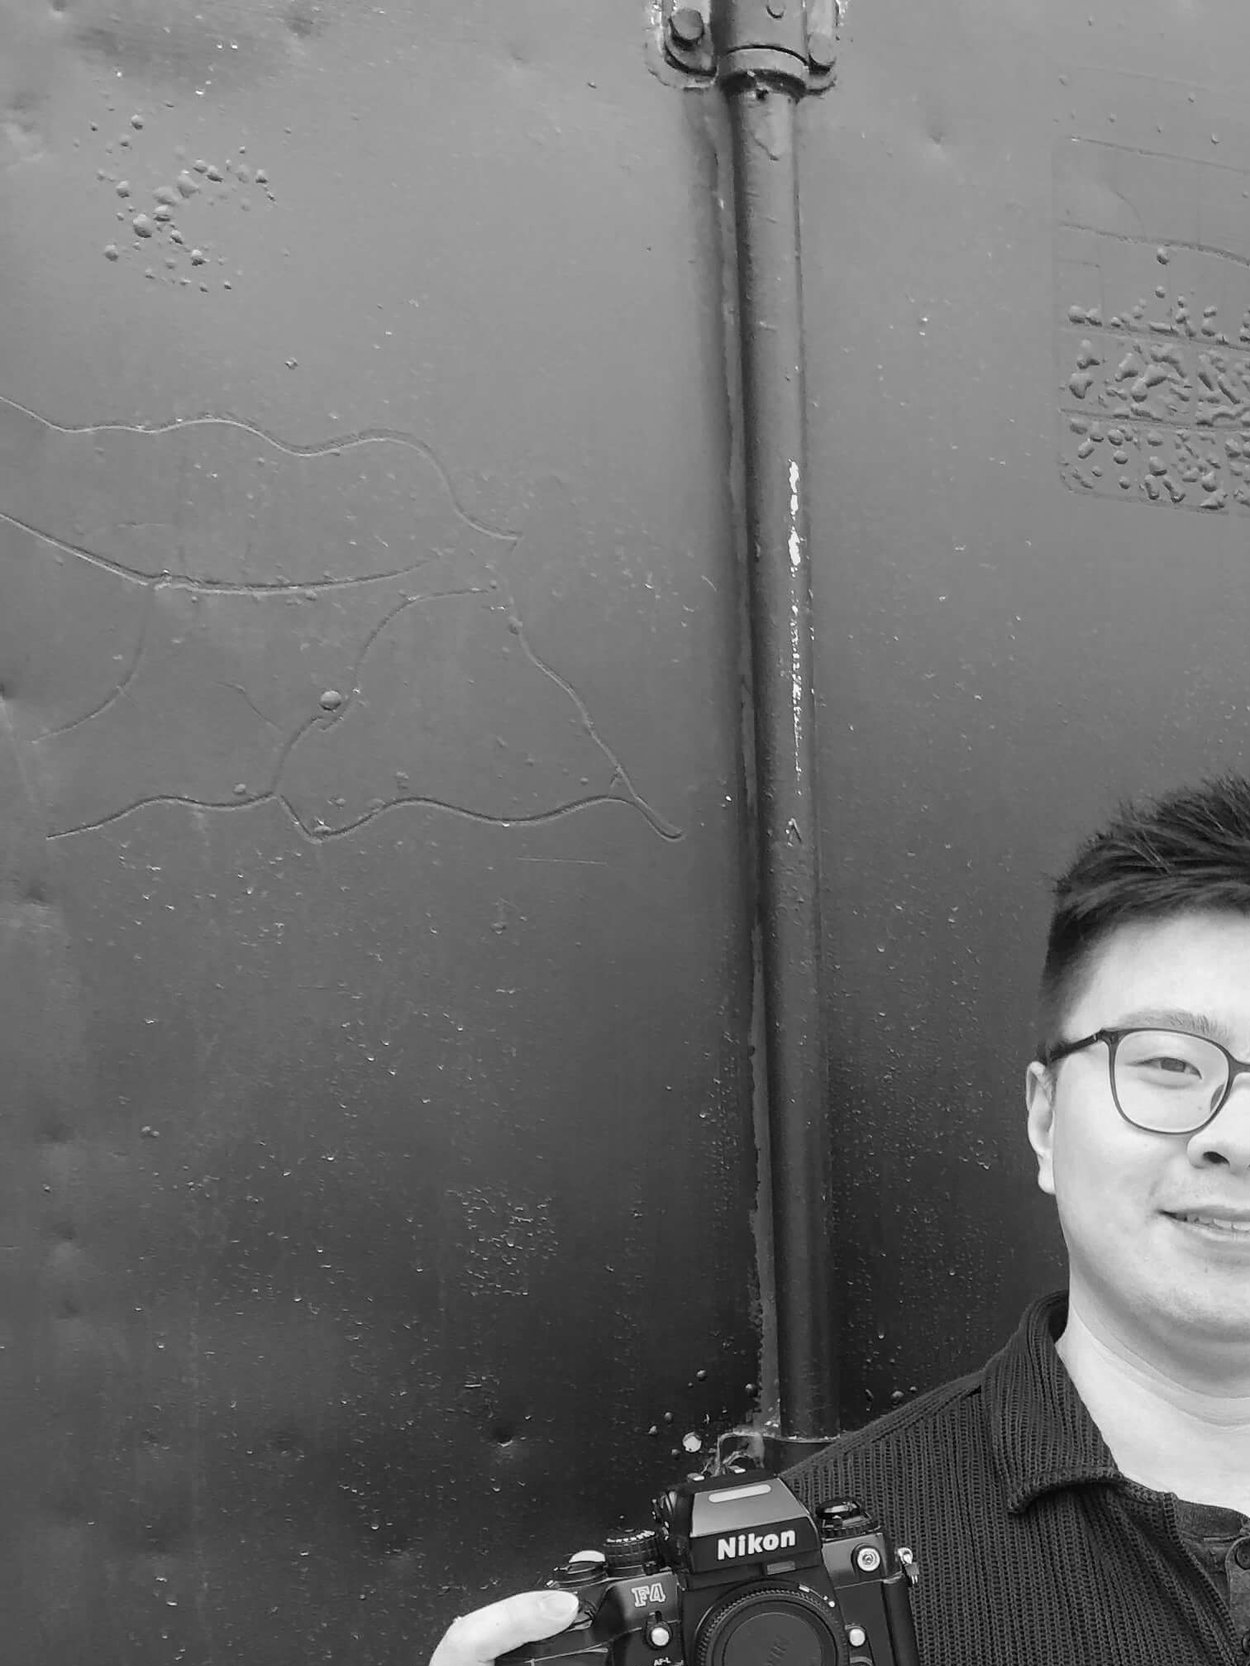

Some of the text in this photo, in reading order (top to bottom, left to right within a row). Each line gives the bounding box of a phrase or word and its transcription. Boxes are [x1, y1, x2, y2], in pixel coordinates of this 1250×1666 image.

[717, 1528, 797, 1561] Nikon
[631, 1582, 666, 1608] F4
[653, 1657, 672, 1666] AF-L
